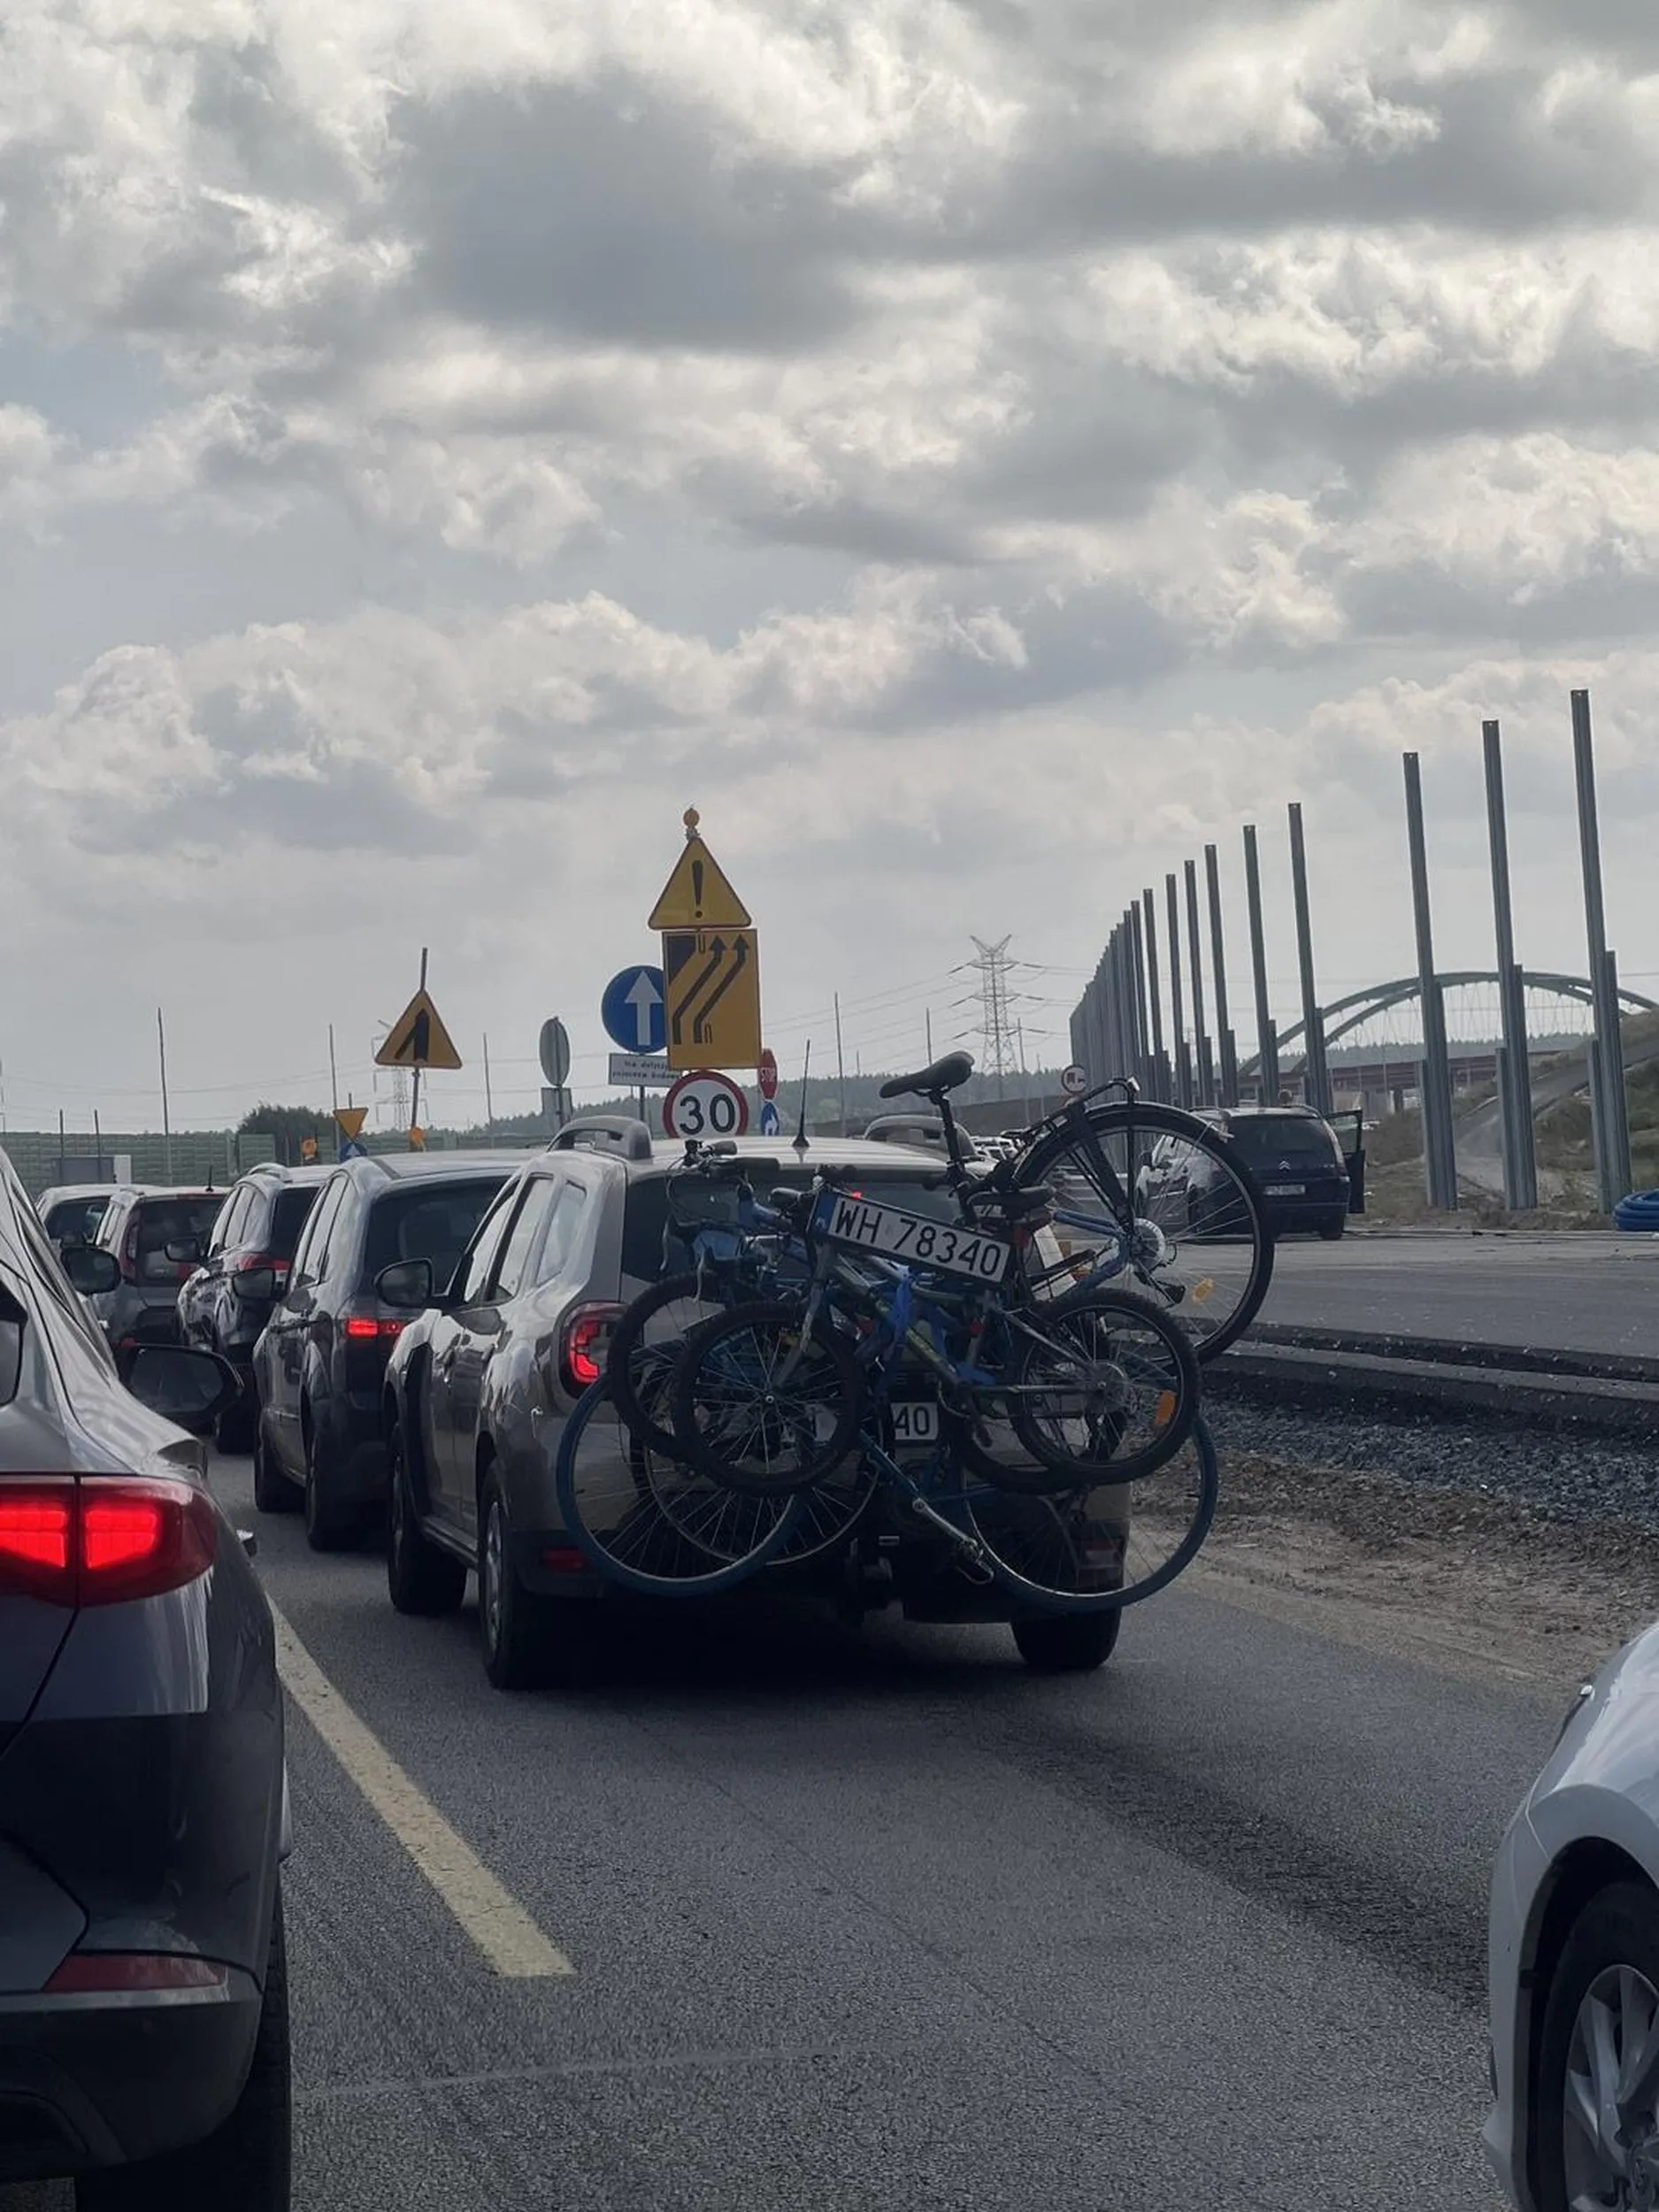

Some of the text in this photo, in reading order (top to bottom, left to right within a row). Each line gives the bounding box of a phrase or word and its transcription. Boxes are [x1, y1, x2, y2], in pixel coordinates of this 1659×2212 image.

[680, 1094, 735, 1135] 30
[834, 1200, 1002, 1276] WH 78340
[894, 1405, 931, 1437] 40
